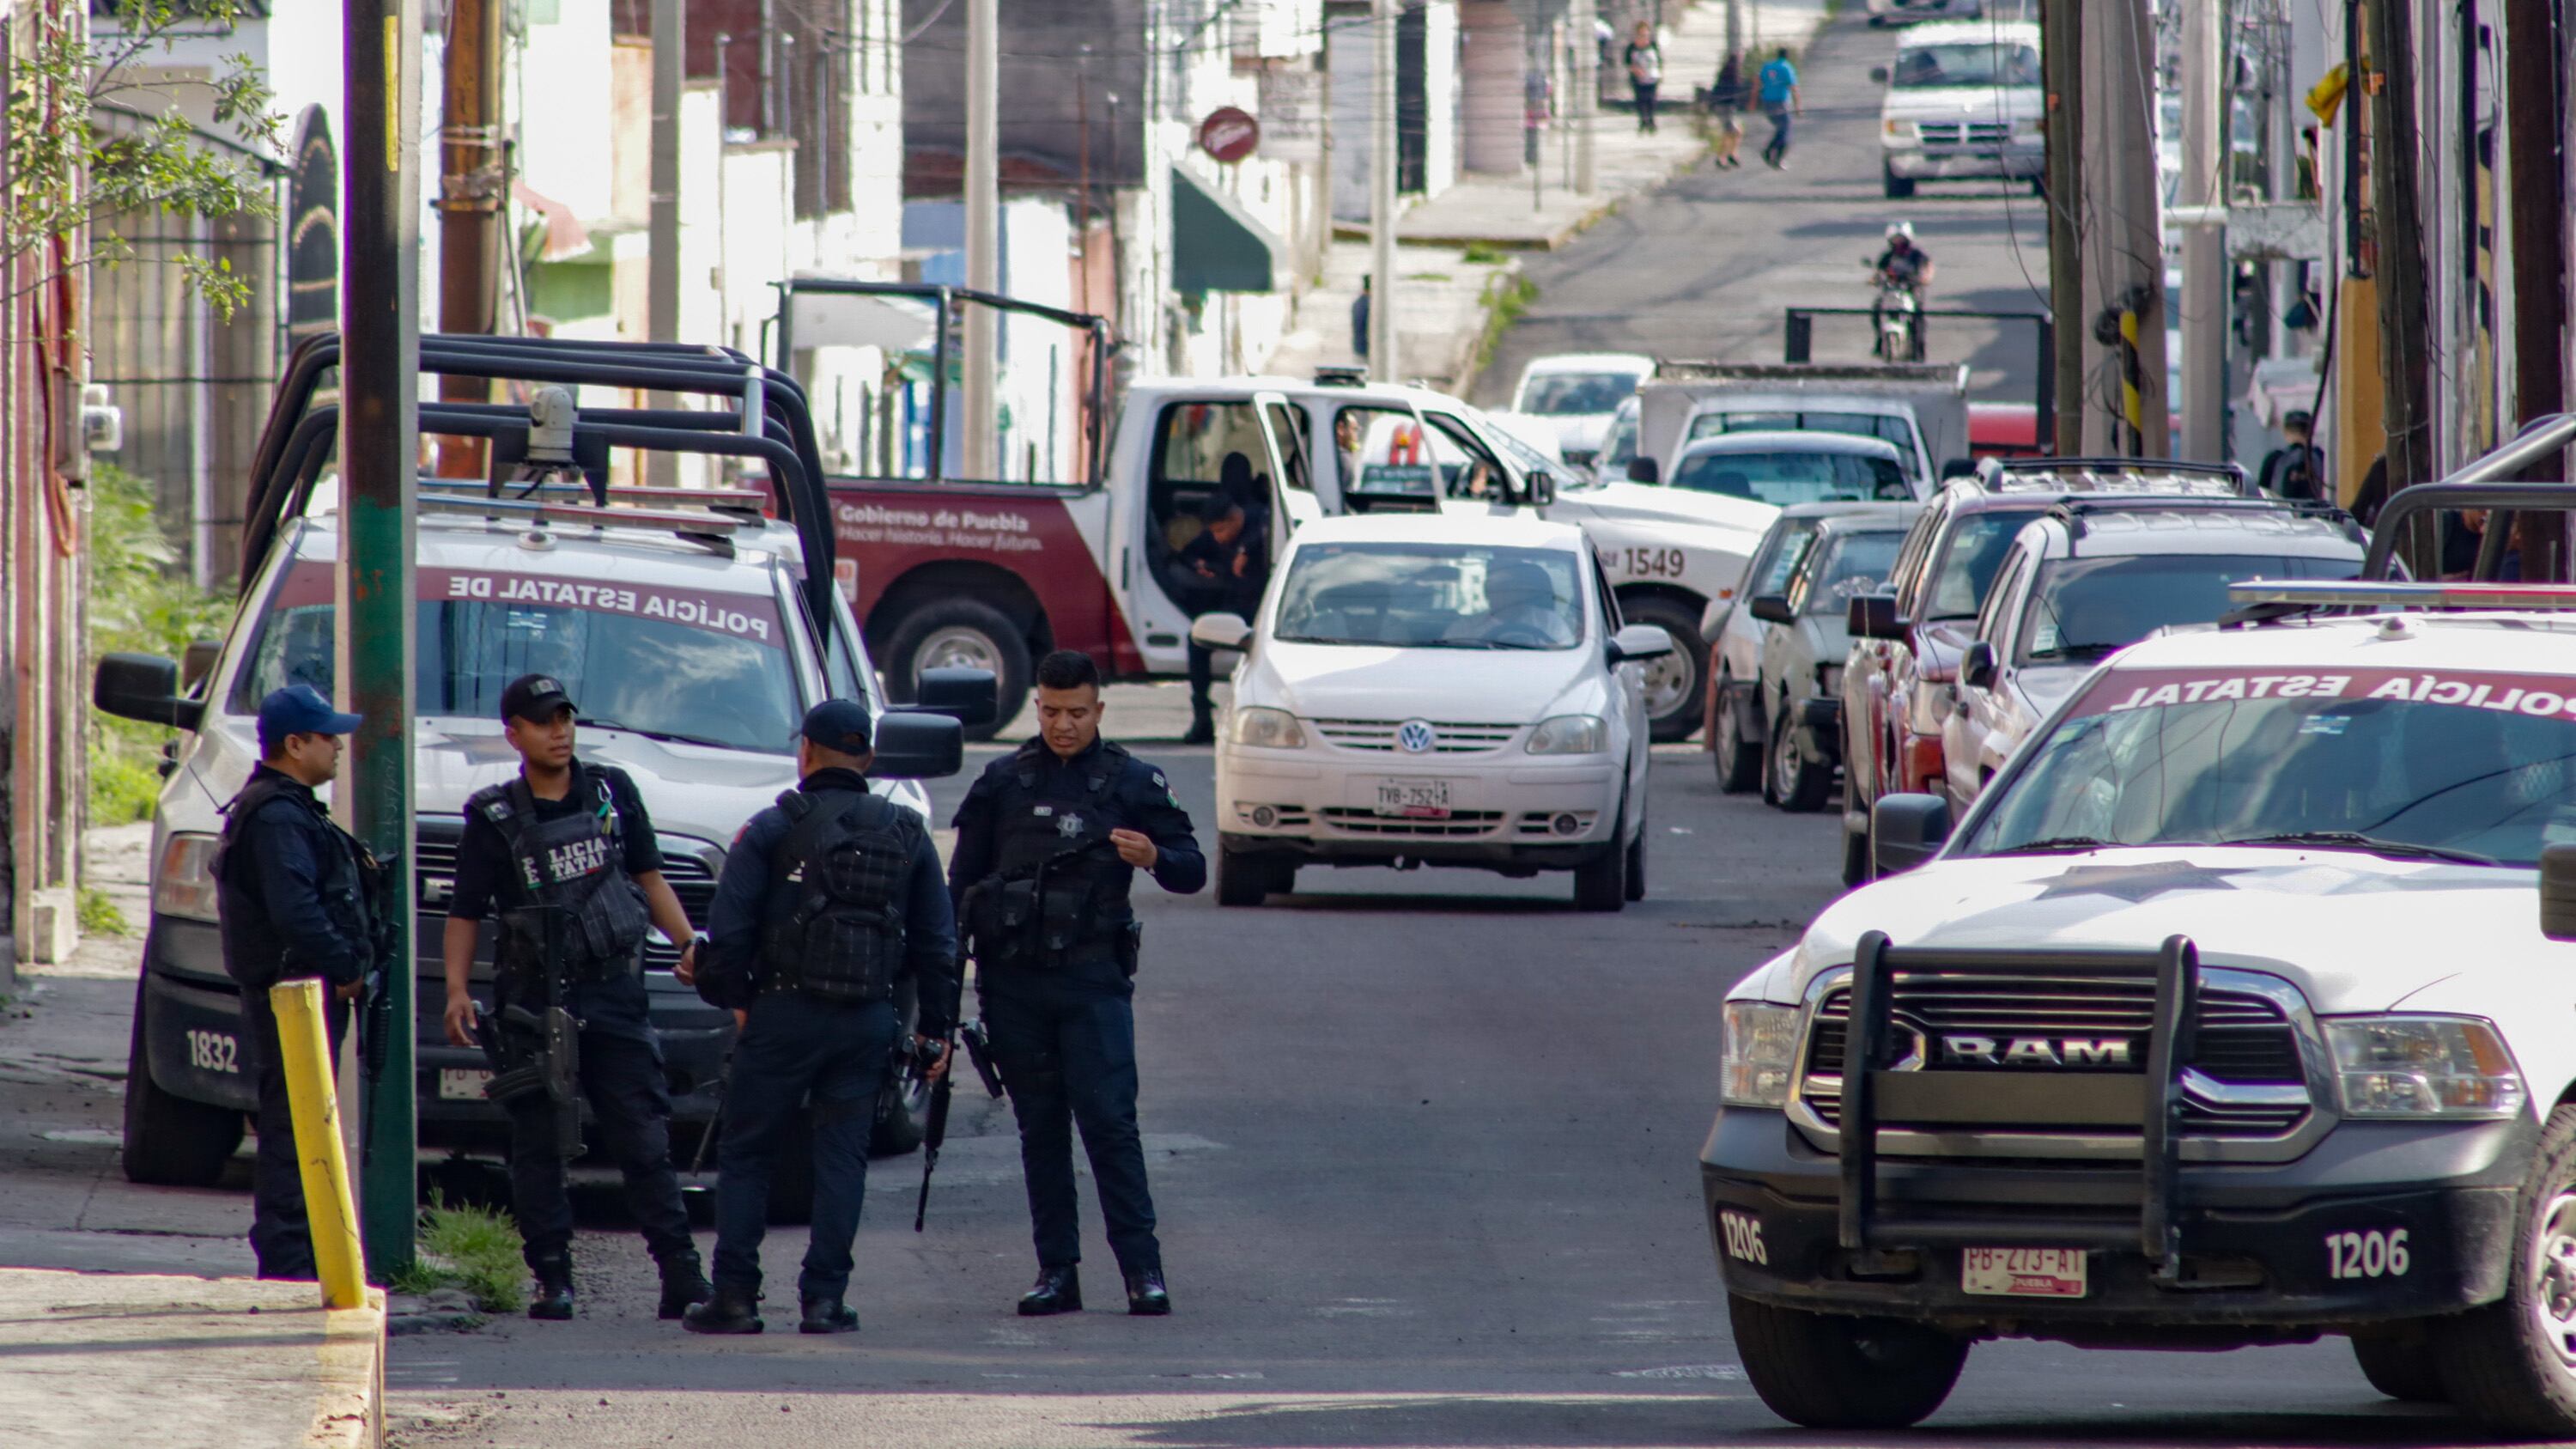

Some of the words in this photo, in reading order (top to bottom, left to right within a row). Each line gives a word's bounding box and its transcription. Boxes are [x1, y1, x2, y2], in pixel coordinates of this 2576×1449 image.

[838, 503, 929, 527] Gobierno
[933, 509, 959, 528] de
[962, 511, 1030, 533] Puebla
[838, 526, 882, 542] Hacer
[947, 532, 991, 549] Hacer
[1625, 547, 1685, 578] 1549
[522, 837, 608, 871] PLICIA
[525, 851, 605, 885] ETATA
[186, 1030, 240, 1074] 1832
[1942, 1036, 2130, 1065] RAM
[1720, 1211, 1768, 1266] 1206
[2325, 1227, 2410, 1279] 1206
